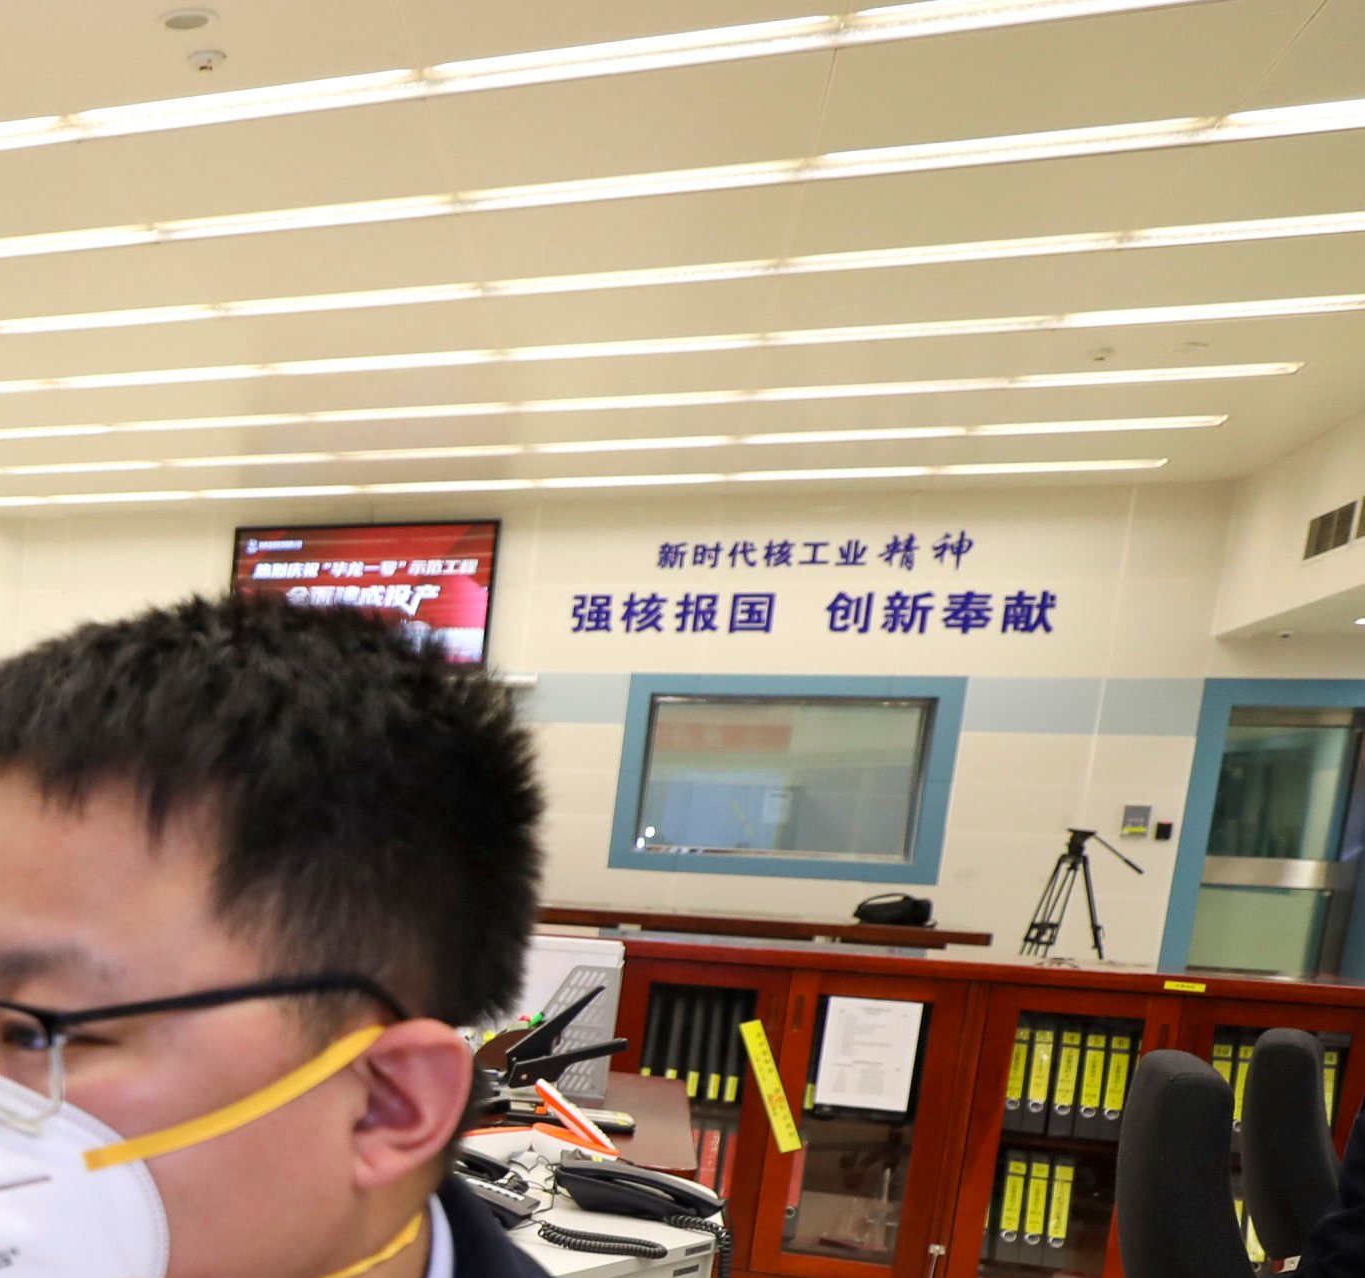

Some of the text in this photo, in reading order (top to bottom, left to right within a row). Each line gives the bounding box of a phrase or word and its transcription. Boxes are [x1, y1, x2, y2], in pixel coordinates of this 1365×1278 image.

[570, 590, 1058, 635] 强核报国 创新奉献
